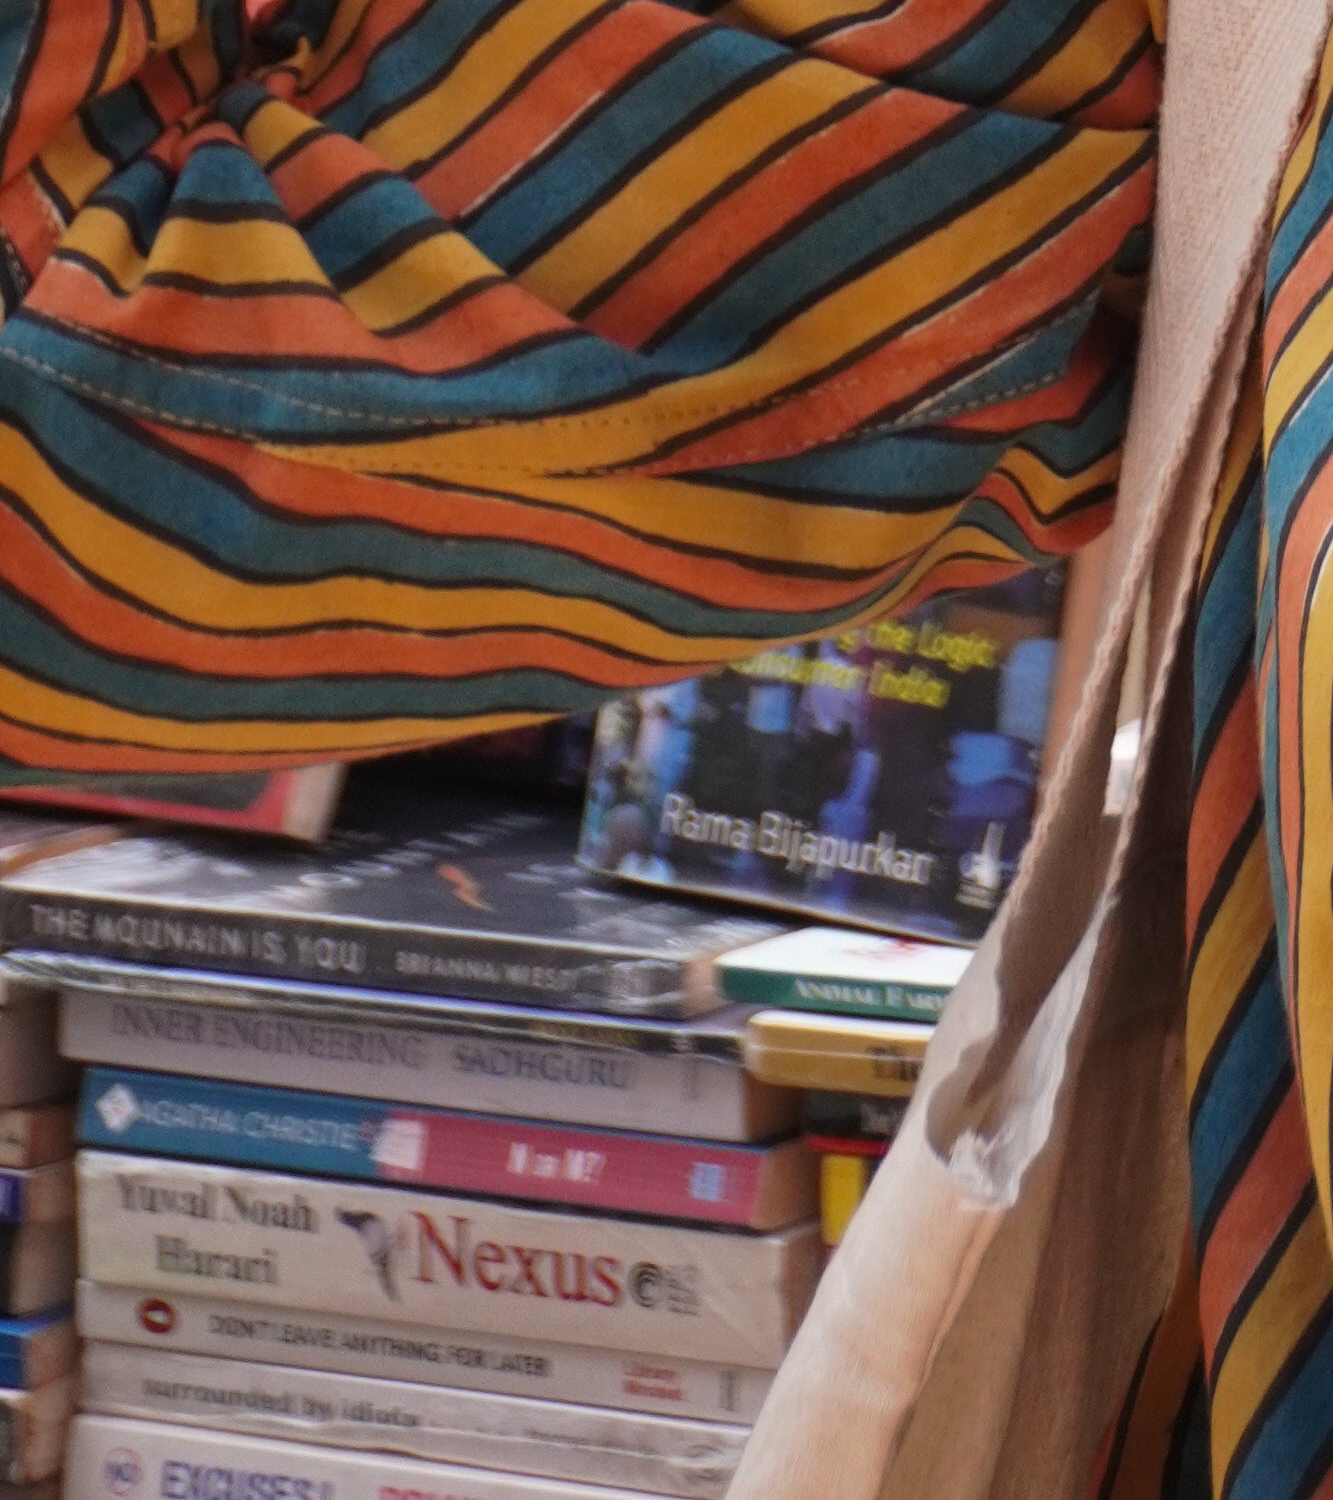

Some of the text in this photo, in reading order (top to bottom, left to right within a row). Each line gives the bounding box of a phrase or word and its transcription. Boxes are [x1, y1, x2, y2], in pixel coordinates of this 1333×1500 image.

[660, 791, 940, 887] Rama Bijapurkar
[30, 904, 88, 942] THE
[251, 930, 287, 965] IS
[294, 933, 367, 975] YOU
[112, 1005, 423, 1069] INNER ENGINEERING
[453, 1043, 636, 1090] SADHGURU
[139, 1100, 361, 1151] AGATHA CHRISTIE
[114, 1171, 320, 1234] Yuval Noah
[153, 1233, 278, 1286] Harari
[409, 1208, 624, 1308] Nexus
[277, 1322, 338, 1350] LEAVE
[341, 1332, 442, 1364] ANYTHING
[446, 1345, 485, 1369] FOR
[489, 1350, 552, 1379] LATER
[144, 1377, 293, 1415] surrounded
[300, 1392, 335, 1422] by
